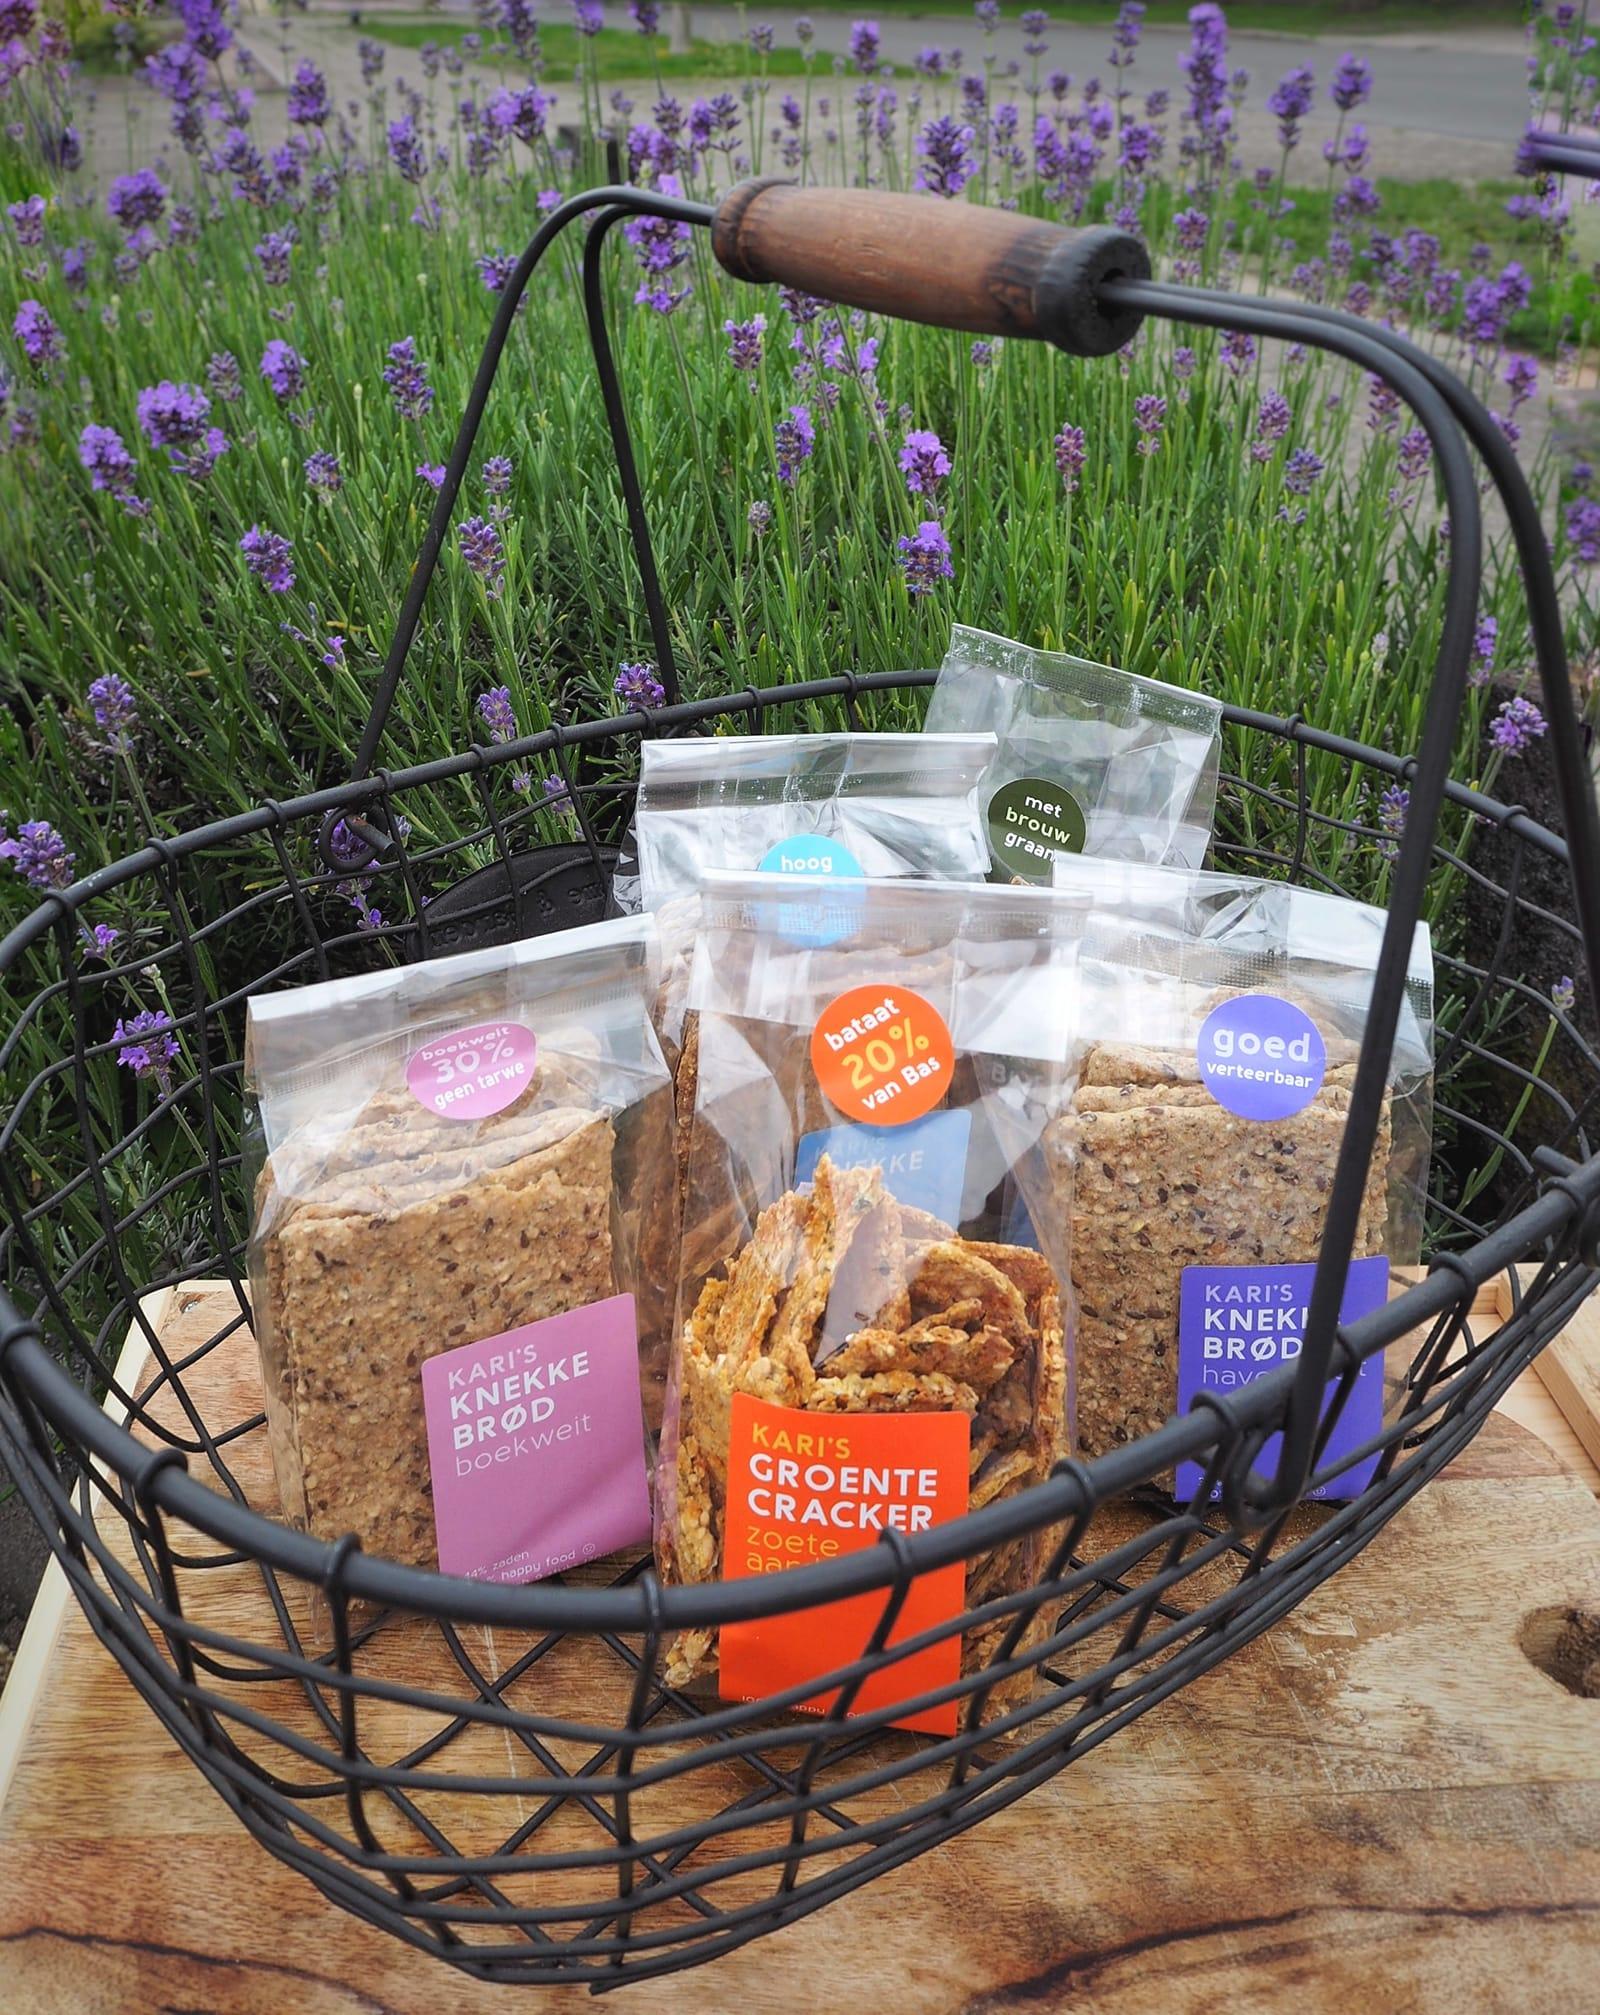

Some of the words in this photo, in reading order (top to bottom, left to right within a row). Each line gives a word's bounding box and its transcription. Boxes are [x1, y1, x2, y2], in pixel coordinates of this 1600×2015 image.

[1006, 806, 1071, 844] brouw
[1025, 796, 1062, 818] met
[781, 855, 833, 873] hoog
[1004, 832, 1056, 862] graan
[824, 997, 900, 1051] bataat
[421, 1027, 510, 1061] boekweit
[432, 1038, 514, 1084] 30%
[841, 1017, 929, 1090] 20%
[1212, 1028, 1311, 1062] goed
[434, 1083, 475, 1110] geen
[477, 1062, 525, 1089] tarwe
[861, 1081, 901, 1111] van
[901, 1055, 941, 1086] Bas
[1206, 1062, 1313, 1088] verteerbaar
[1205, 1284, 1293, 1303] KARI'S
[1204, 1307, 1309, 1331] KNEK
[448, 1344, 537, 1390] KARI'S
[1203, 1336, 1304, 1361] BRØD
[450, 1351, 590, 1420] KNEKKE
[453, 1397, 555, 1450] BRØD
[752, 1422, 851, 1459] KARI'S
[456, 1413, 592, 1477] boekweit
[749, 1453, 938, 1497] GROENTE
[747, 1489, 933, 1532] CRACKER
[747, 1526, 840, 1557] zoete
[501, 1562, 541, 1581] happy
[546, 1550, 577, 1567] food
